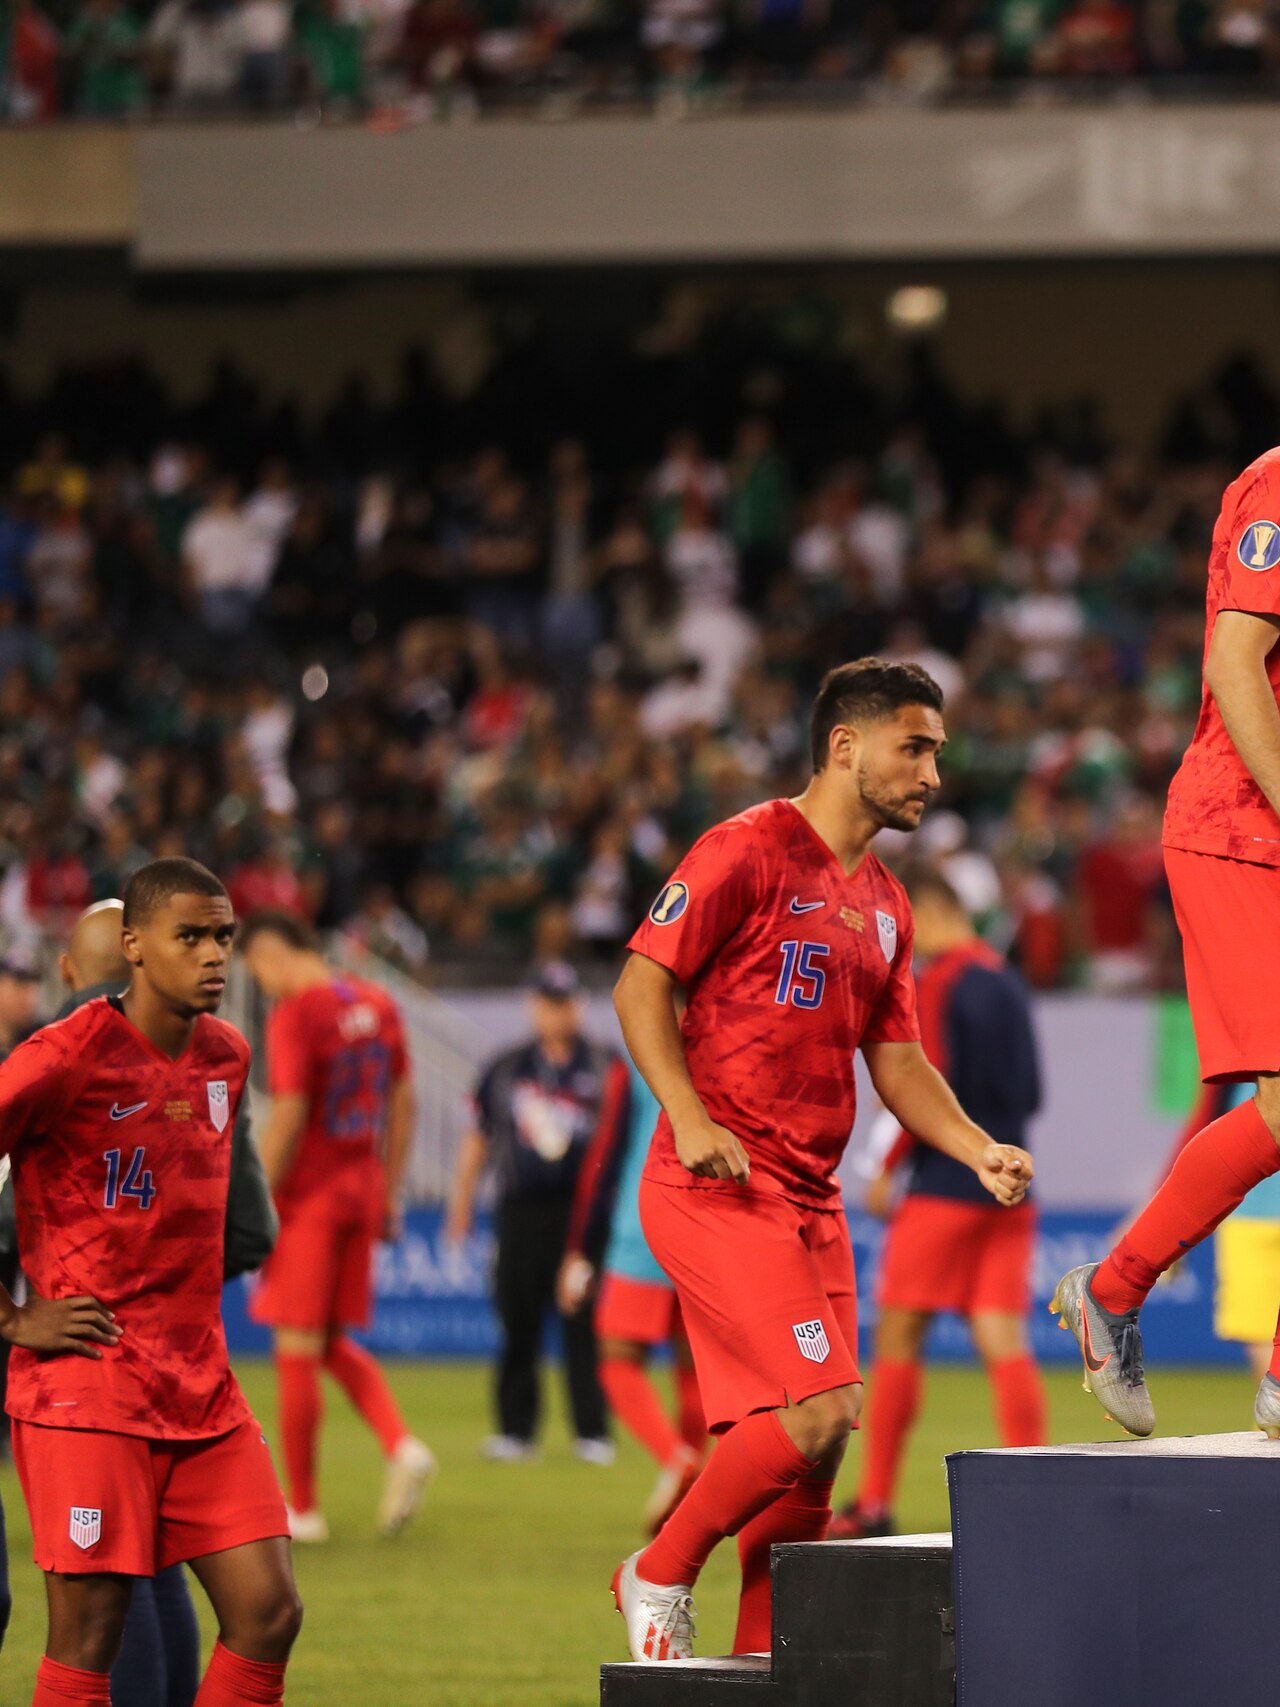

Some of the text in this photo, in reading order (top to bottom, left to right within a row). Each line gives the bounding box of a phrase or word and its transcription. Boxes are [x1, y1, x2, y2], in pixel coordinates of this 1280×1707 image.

[774, 940, 831, 1010] 15
[103, 1146, 156, 1210] 14
[795, 1322, 823, 1340] USA
[73, 1509, 99, 1526] USA
